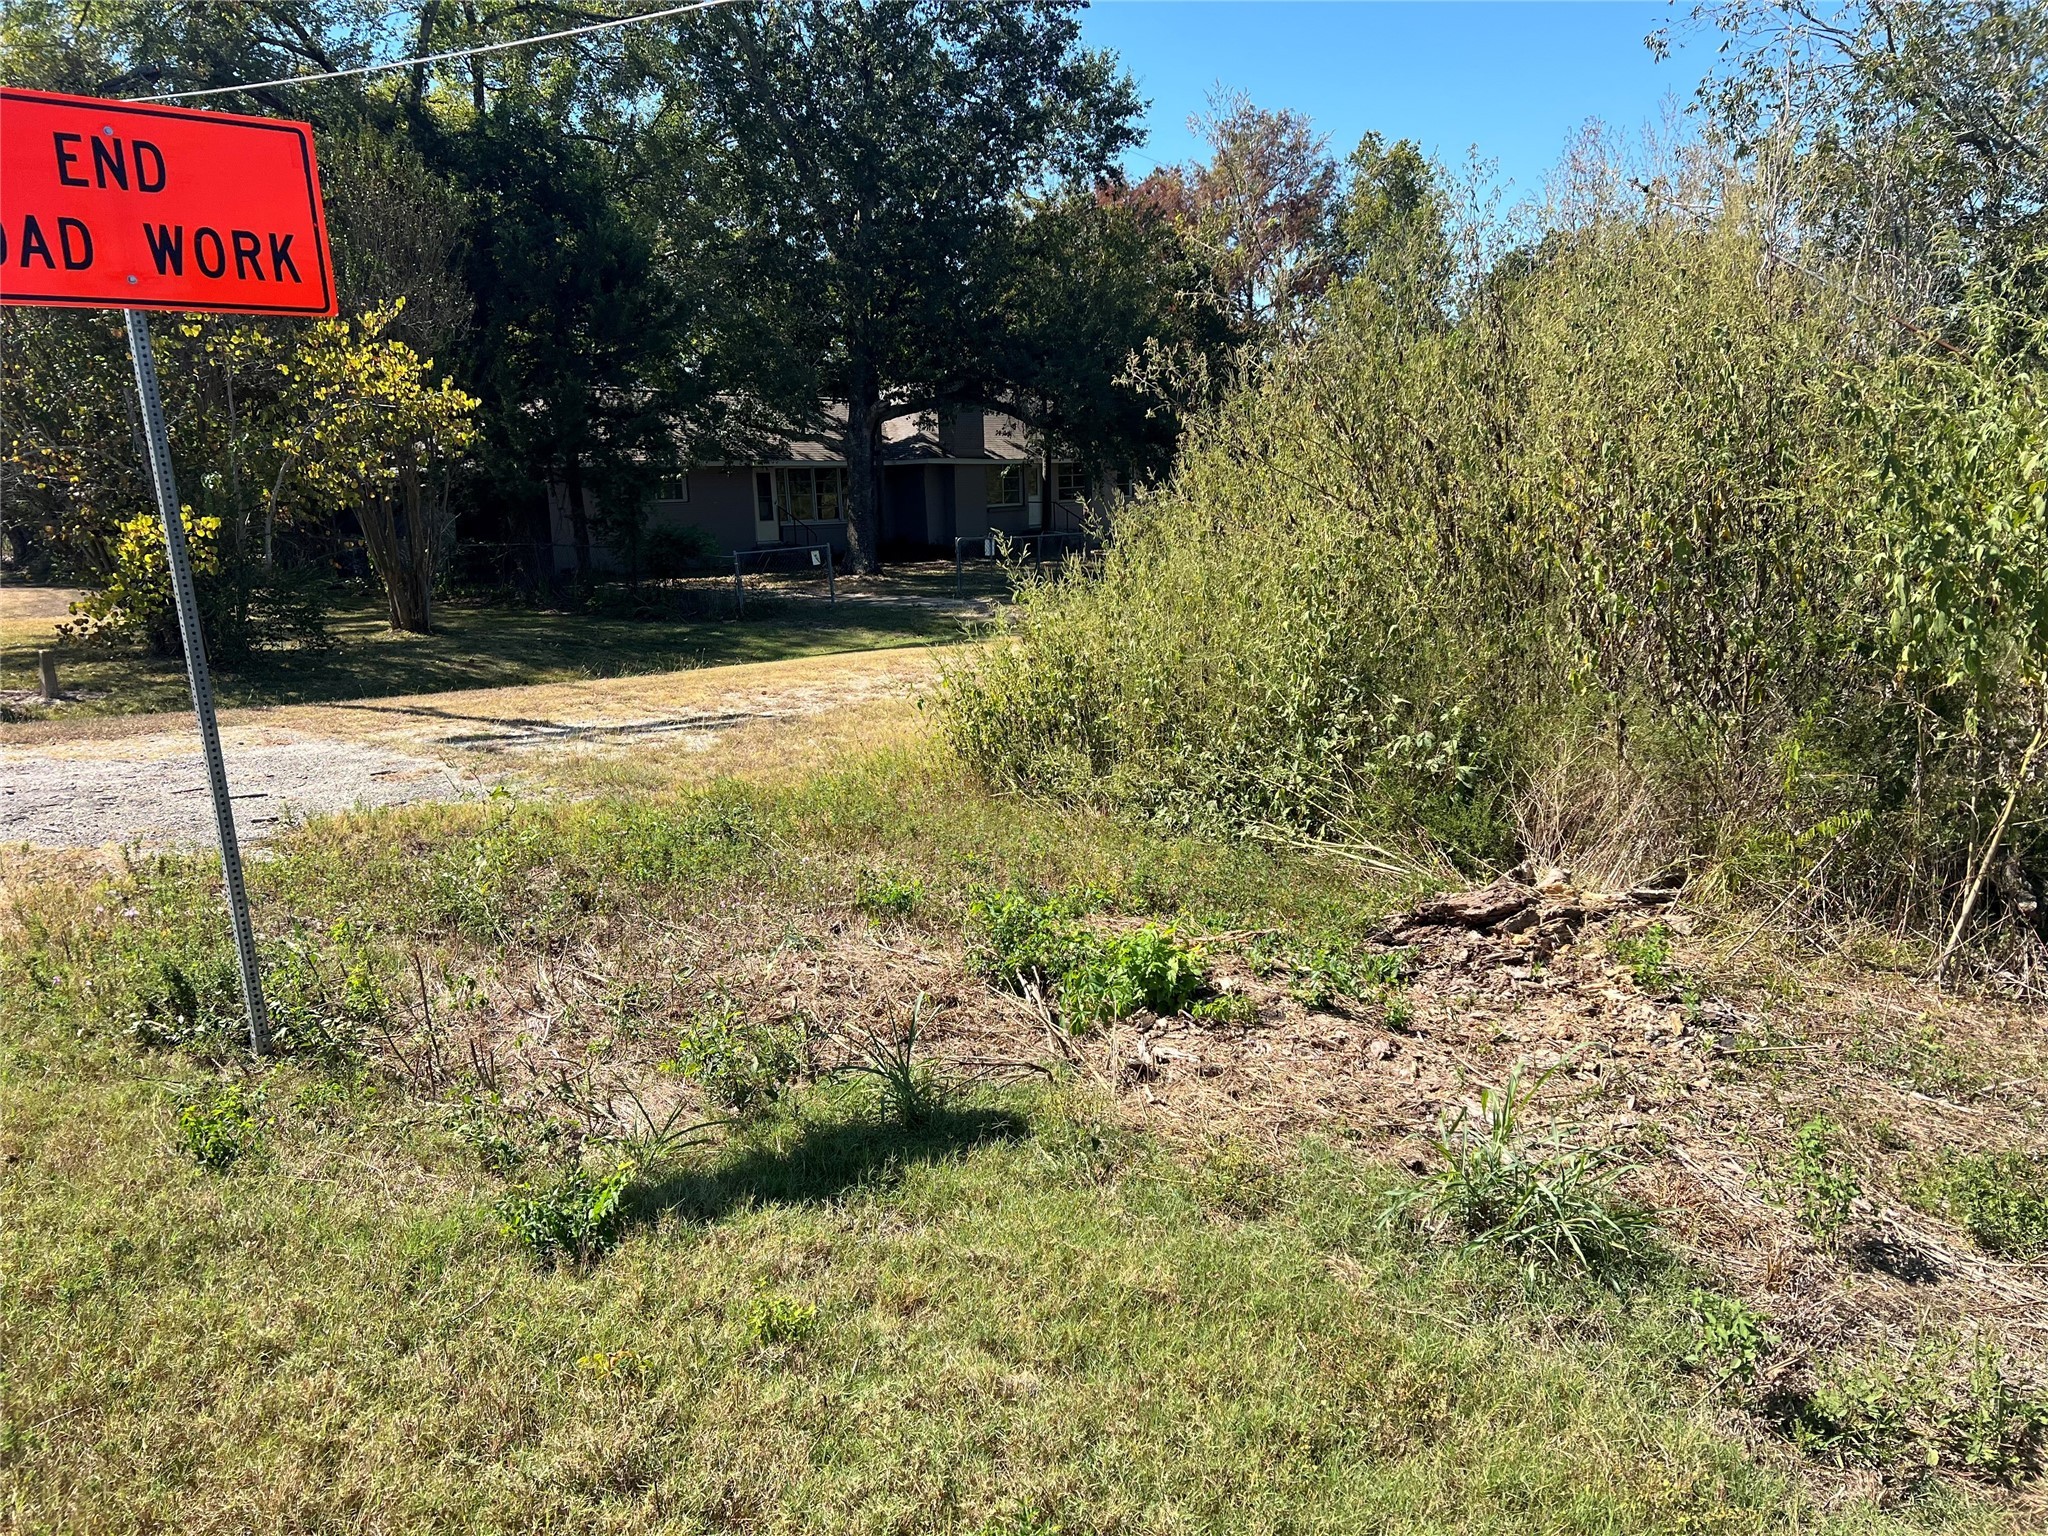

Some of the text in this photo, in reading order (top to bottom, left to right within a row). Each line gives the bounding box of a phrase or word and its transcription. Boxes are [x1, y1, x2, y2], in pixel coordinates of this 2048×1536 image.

[53, 131, 167, 193] END
[0, 214, 302, 283] AD WORK
